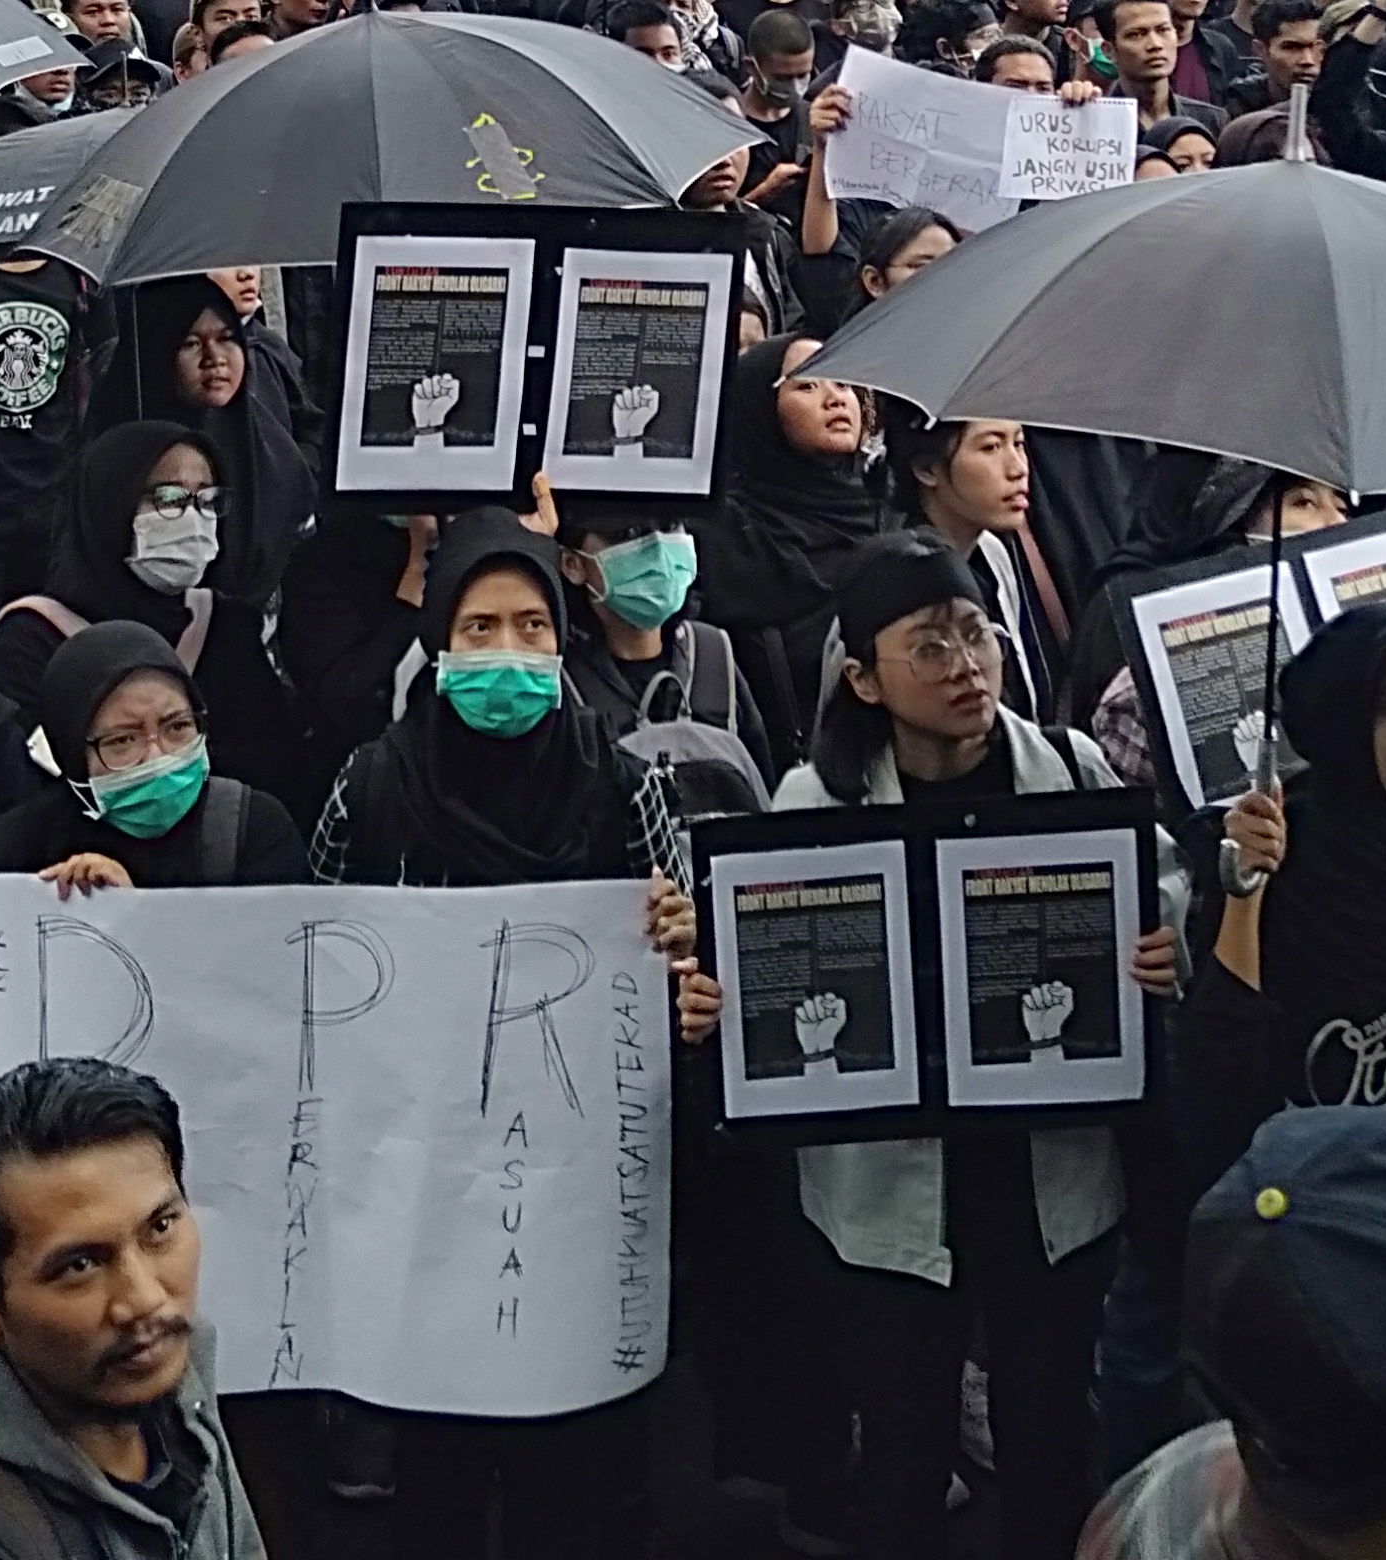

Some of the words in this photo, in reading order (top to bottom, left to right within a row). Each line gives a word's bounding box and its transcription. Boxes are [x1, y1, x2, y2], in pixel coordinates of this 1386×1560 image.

[858, 92, 959, 141] RAKYAT
[1020, 112, 1073, 134] URUS
[1047, 137, 1122, 156] KORUPSI
[1012, 159, 1076, 178] JANGN
[1085, 160, 1128, 181] USIK
